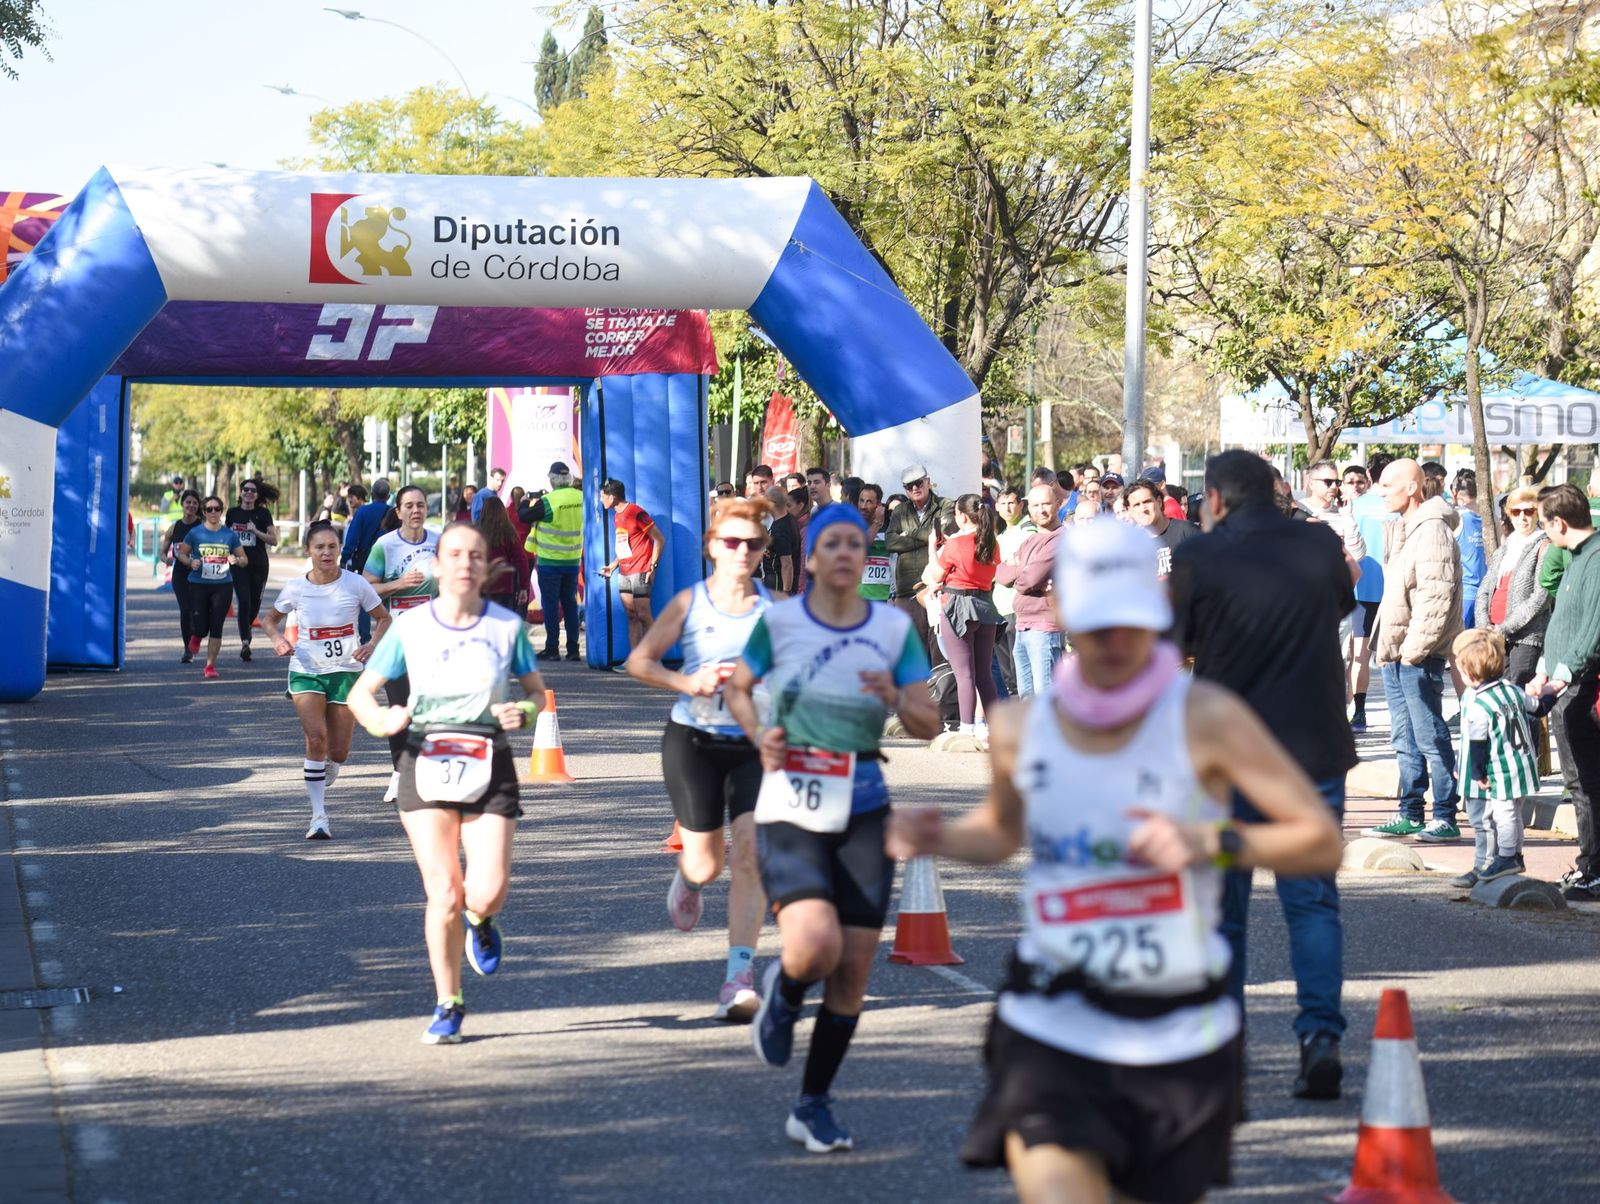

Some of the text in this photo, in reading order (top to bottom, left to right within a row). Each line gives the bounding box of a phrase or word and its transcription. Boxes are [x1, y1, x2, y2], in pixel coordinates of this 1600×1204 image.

[433, 215, 620, 250] Diputación
[431, 254, 620, 281] de Córdoba
[586, 315, 677, 330] SE TRATA DE
[585, 330, 645, 344] CORRER
[585, 342, 636, 358] MEJOR
[12, 506, 45, 518] Córdoba
[868, 566, 887, 579] 202
[324, 639, 343, 658] 39
[440, 759, 467, 785] 37
[788, 778, 822, 811] 36
[1070, 924, 1164, 981] 225
